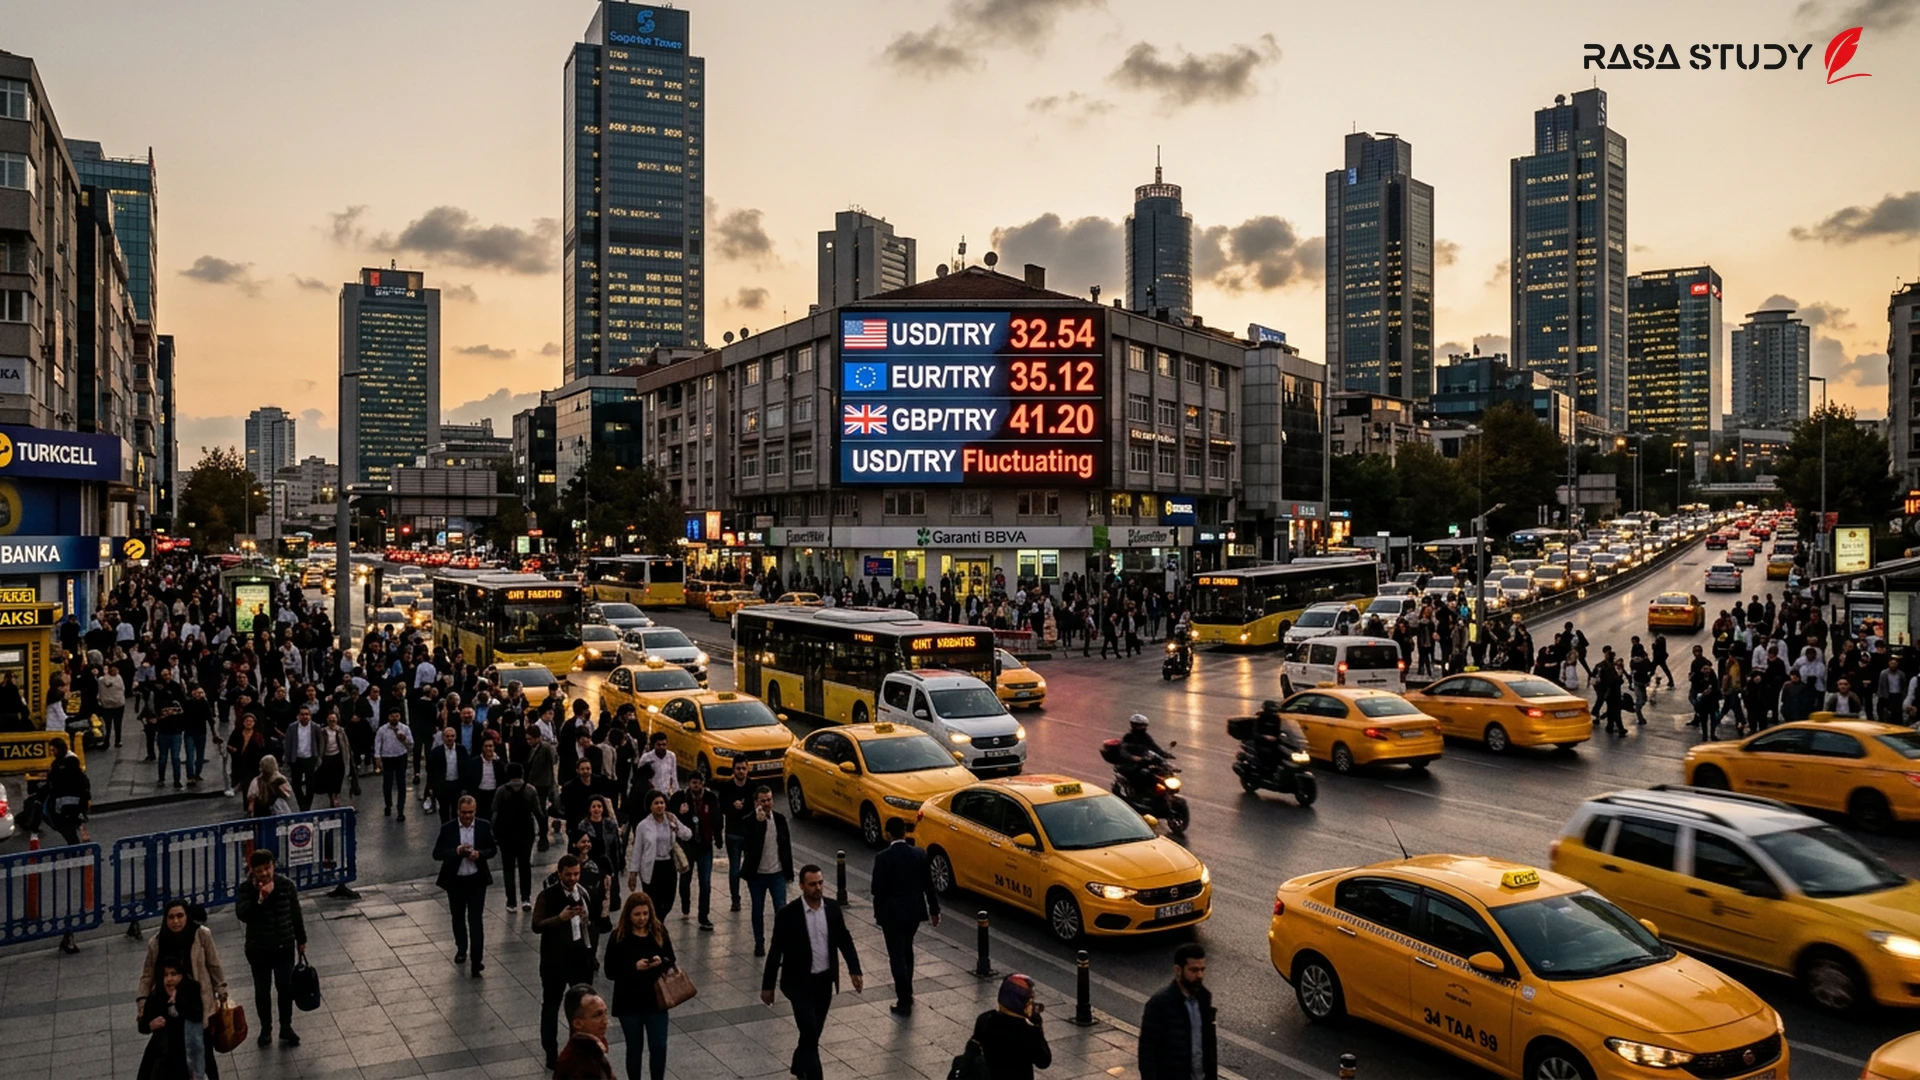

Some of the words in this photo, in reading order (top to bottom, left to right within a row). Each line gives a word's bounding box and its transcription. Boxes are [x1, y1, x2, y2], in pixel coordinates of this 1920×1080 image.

[892, 322, 996, 346] USD/TRY
[1010, 318, 1096, 348] 32.54
[892, 365, 996, 389] EUR/TRY
[1010, 361, 1095, 391] 35.12
[891, 408, 997, 432] GBP/TRY
[1009, 404, 1095, 434] 41.20
[17, 442, 98, 466] TURKCELL
[852, 449, 957, 473] USD/TRY
[962, 449, 1094, 479] Fluctuating
[932, 530, 981, 544] Garanti
[984, 530, 1027, 544] BBVA
[0, 545, 61, 563] BANKA
[1423, 1007, 1441, 1028] 34
[1444, 1014, 1476, 1043] TAA
